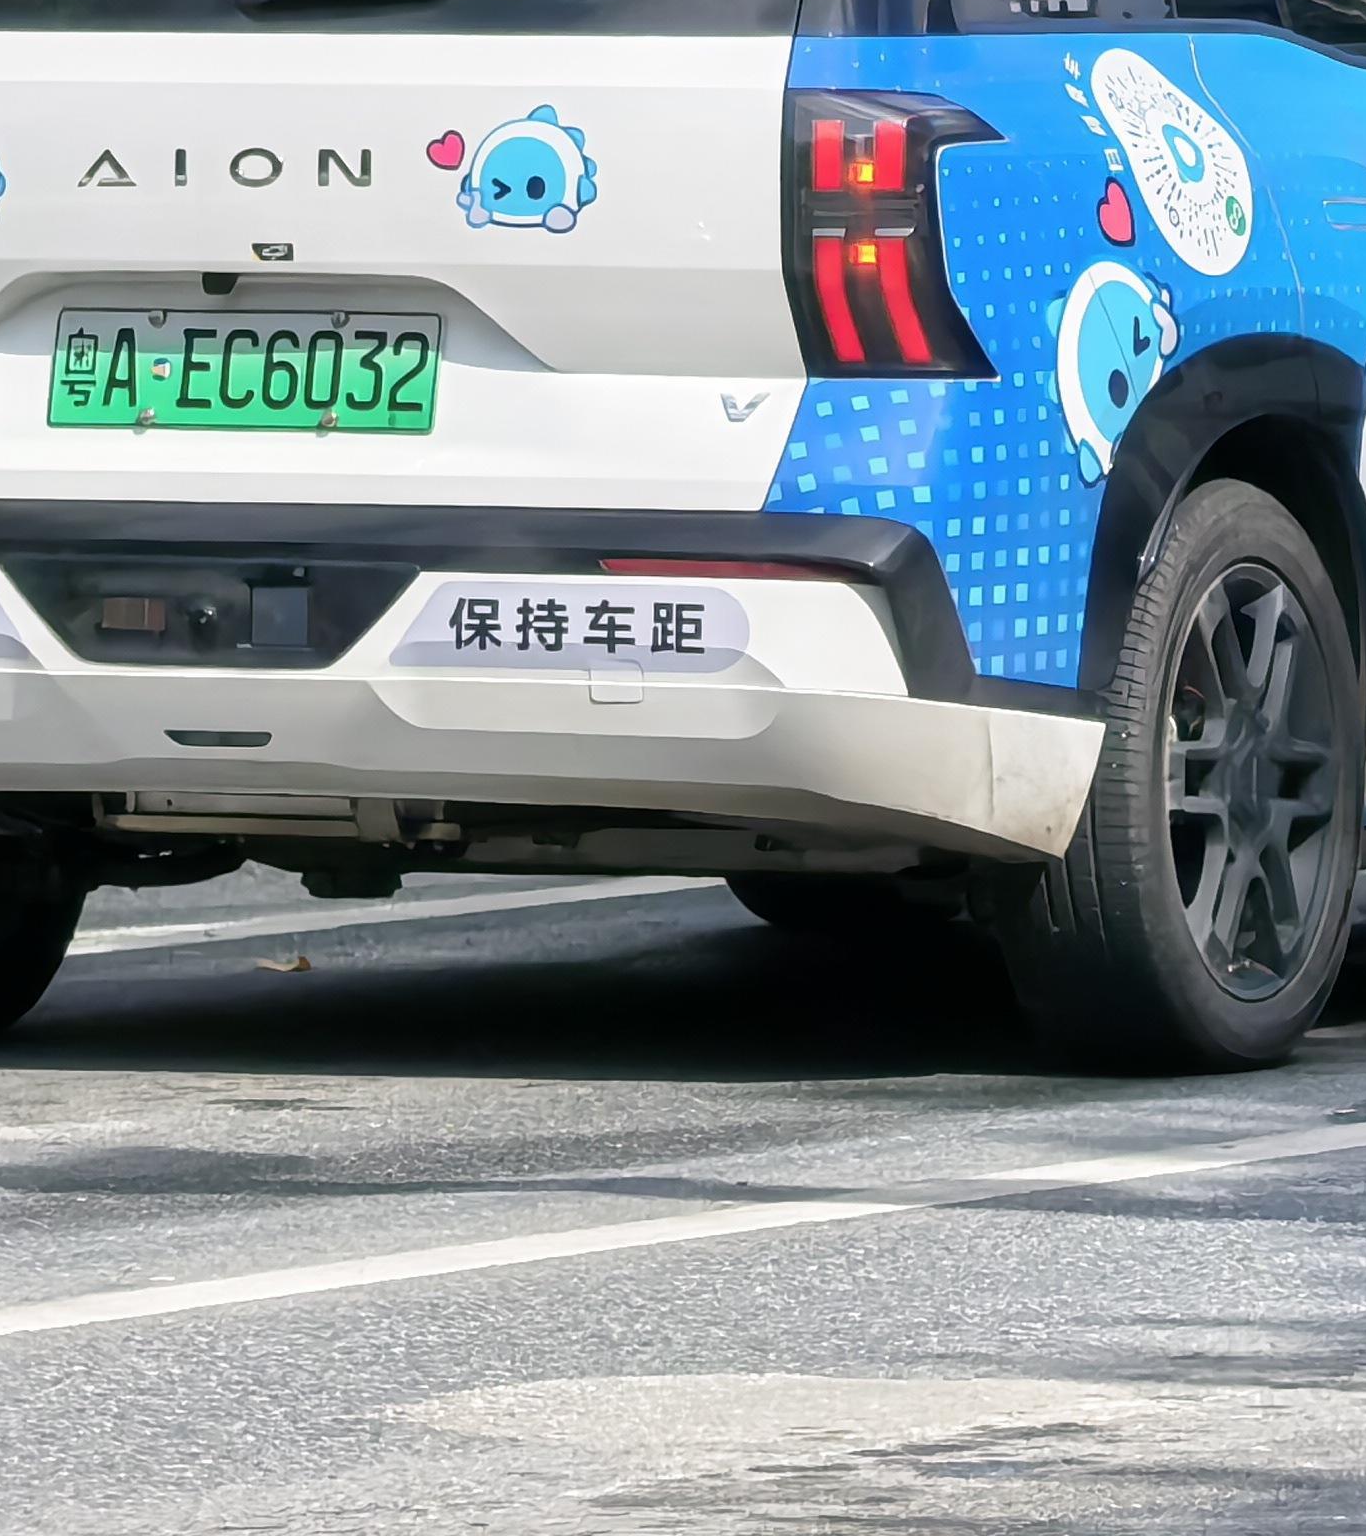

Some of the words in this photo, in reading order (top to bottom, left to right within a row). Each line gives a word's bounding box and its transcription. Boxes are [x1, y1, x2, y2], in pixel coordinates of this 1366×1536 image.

[77, 147, 372, 188] AION
[449, 597, 705, 654] 保持车距
